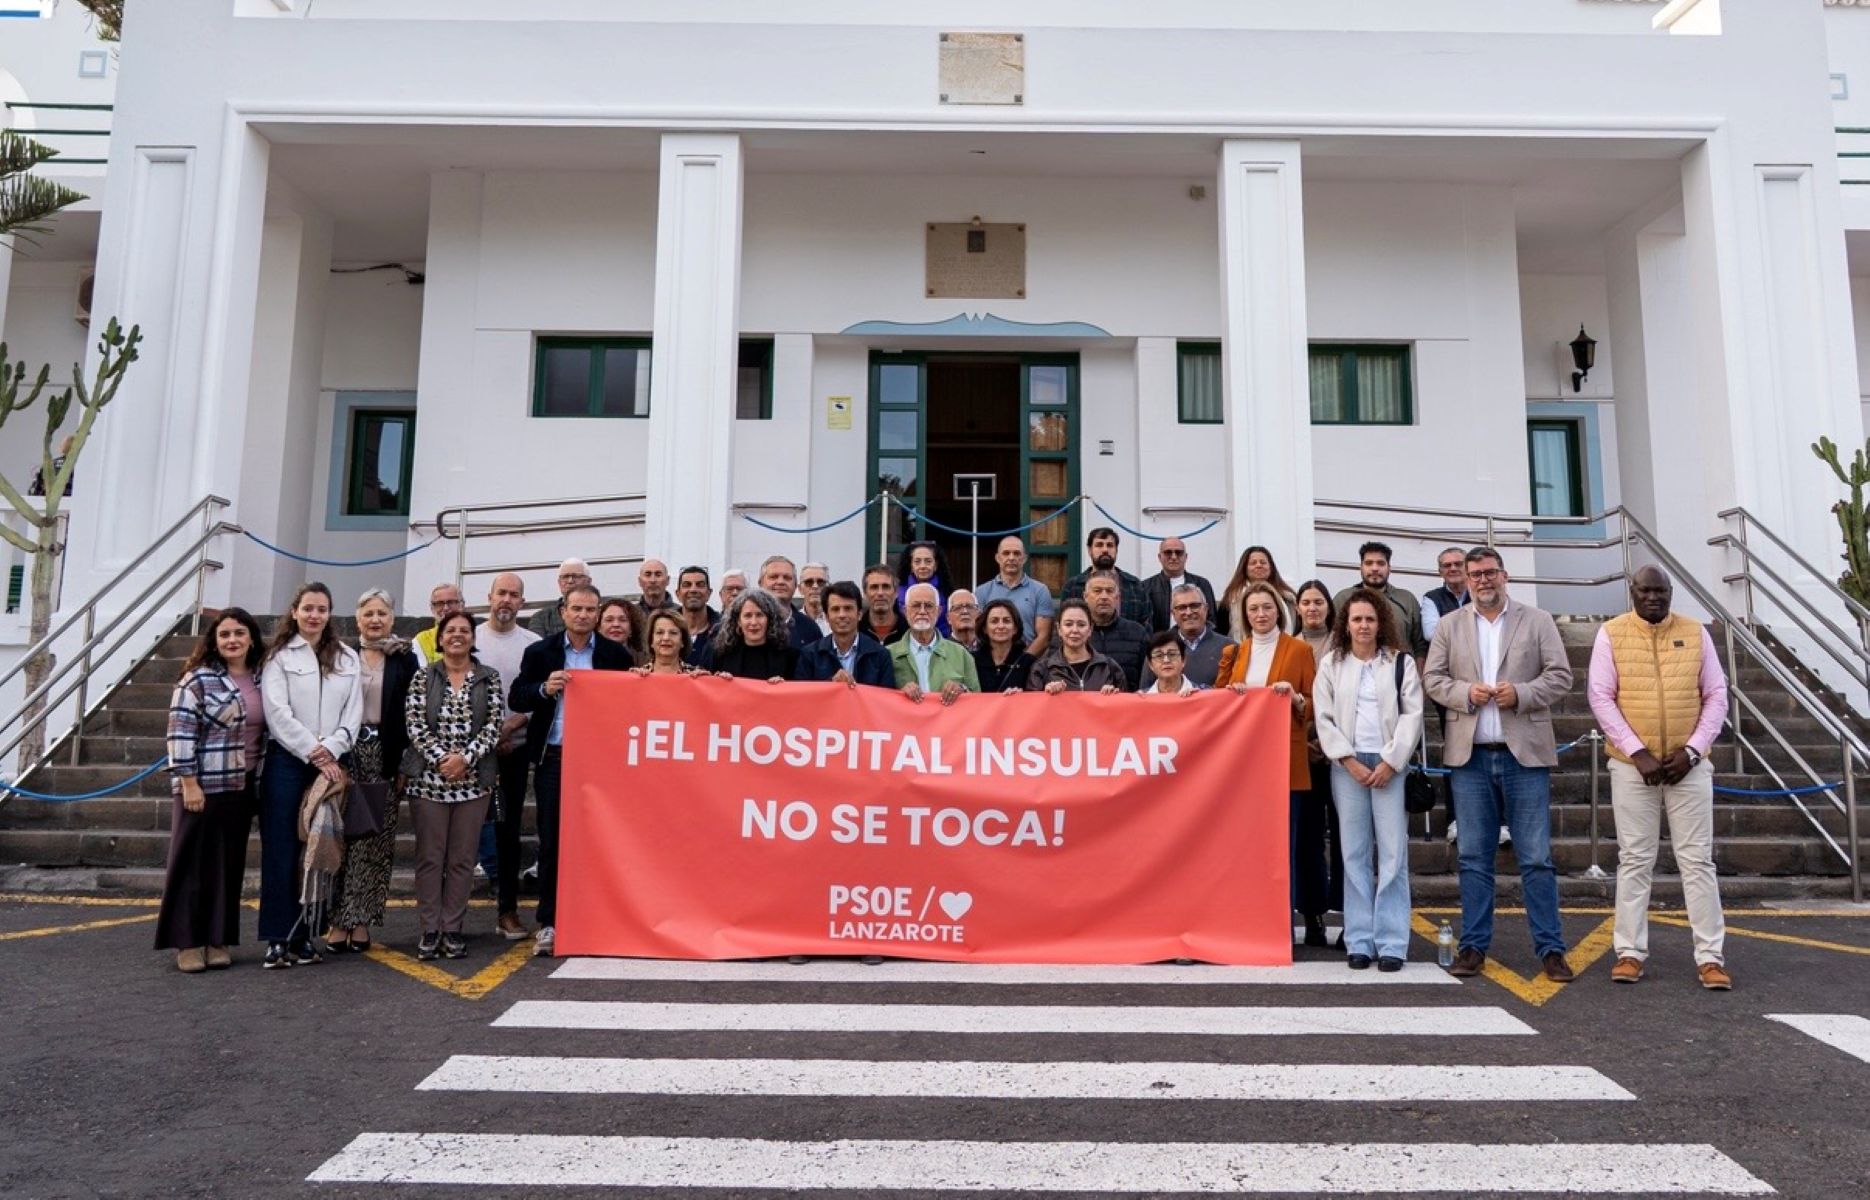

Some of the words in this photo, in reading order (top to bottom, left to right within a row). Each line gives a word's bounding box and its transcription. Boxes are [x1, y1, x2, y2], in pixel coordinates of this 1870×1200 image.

[627, 719, 695, 765] ¡EL
[707, 723, 953, 775] HOSPITAL
[964, 735, 1179, 777] INSULAR
[741, 798, 818, 841] NO
[830, 803, 888, 844] SE
[901, 807, 1065, 847] TOCA!
[829, 885, 913, 916] PSOE
[828, 921, 964, 942] LANZAROTE
